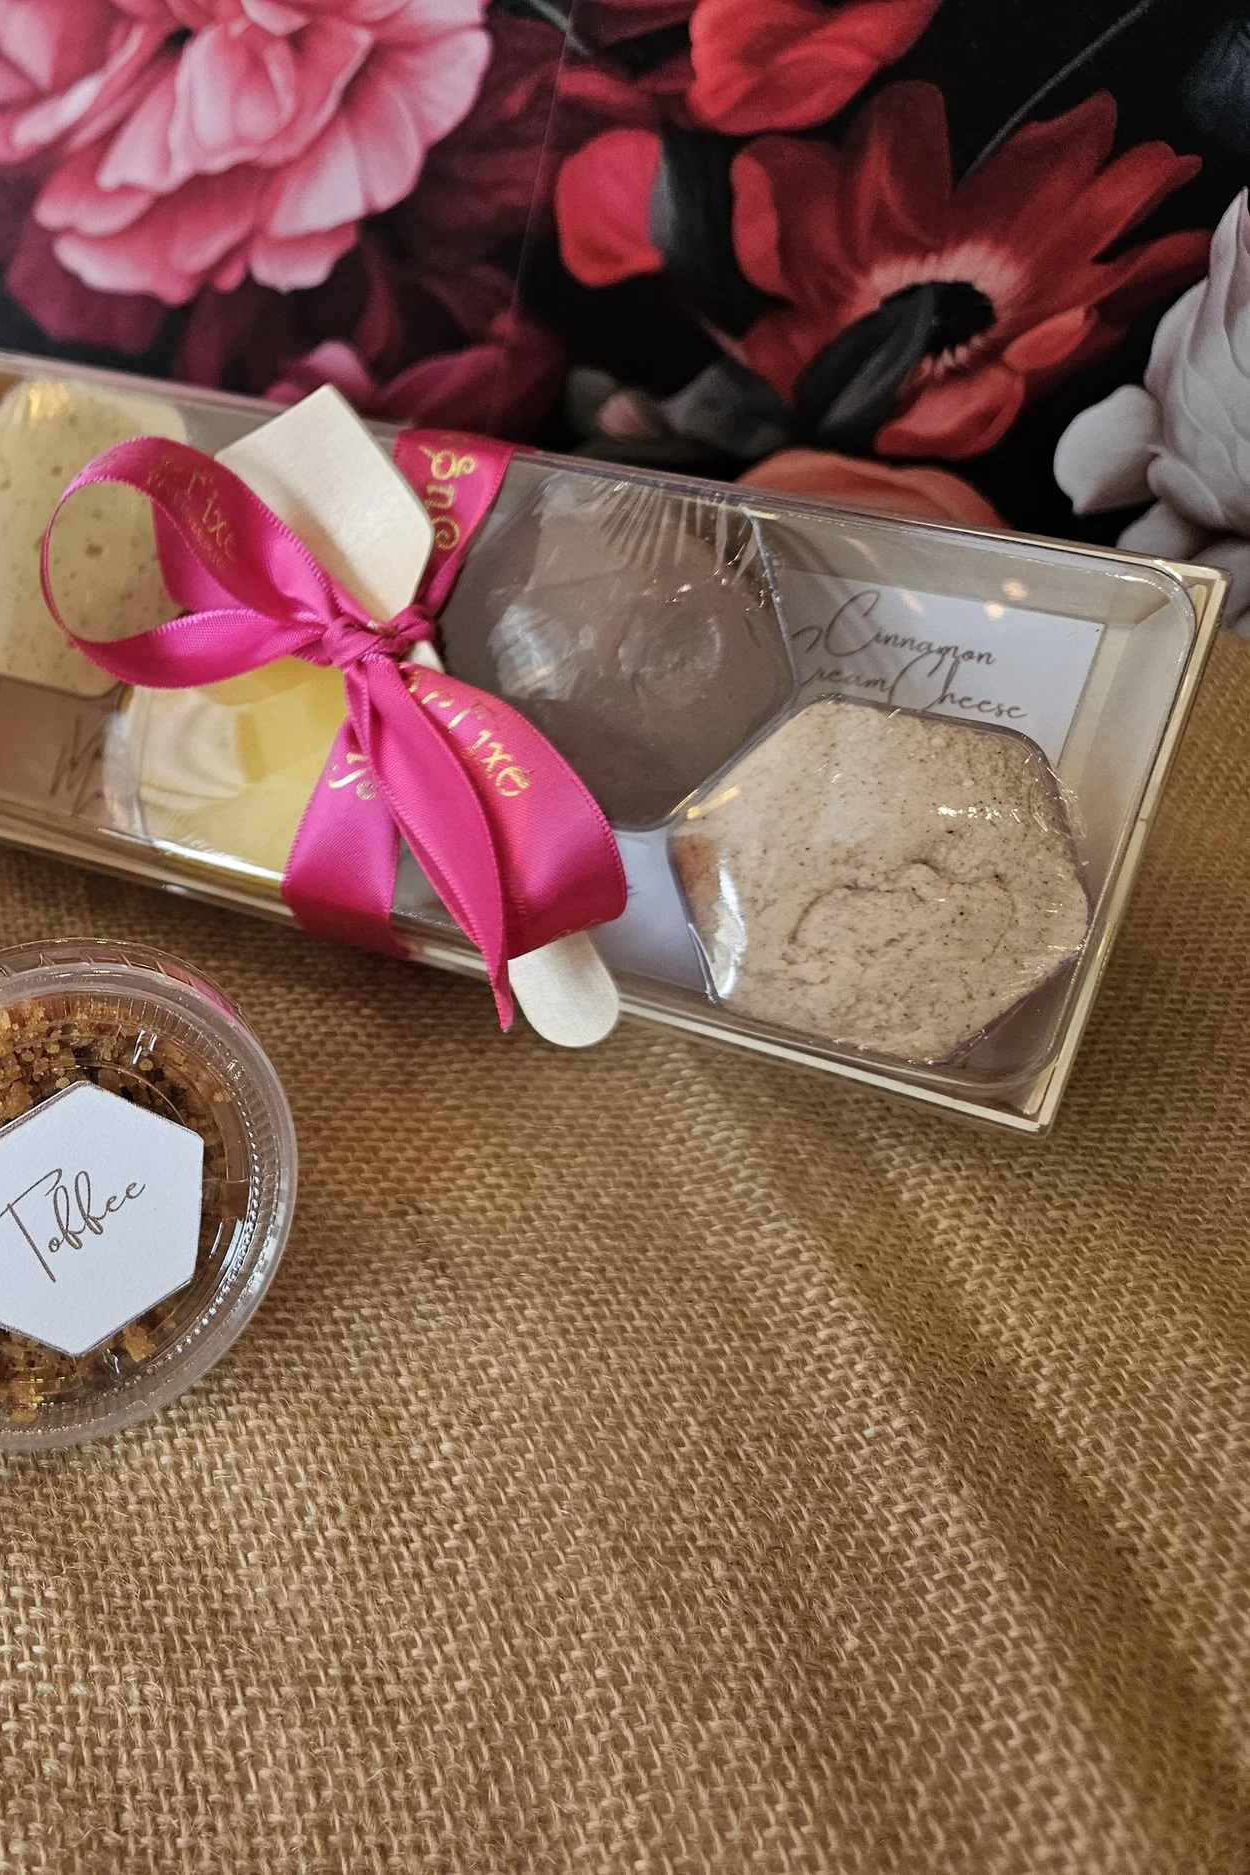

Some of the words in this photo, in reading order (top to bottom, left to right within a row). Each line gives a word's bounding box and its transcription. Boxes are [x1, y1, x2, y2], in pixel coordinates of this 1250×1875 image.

[418, 444, 478, 551] Sug
[824, 588, 997, 666] Cinnamon
[887, 653, 1028, 720] Cheese
